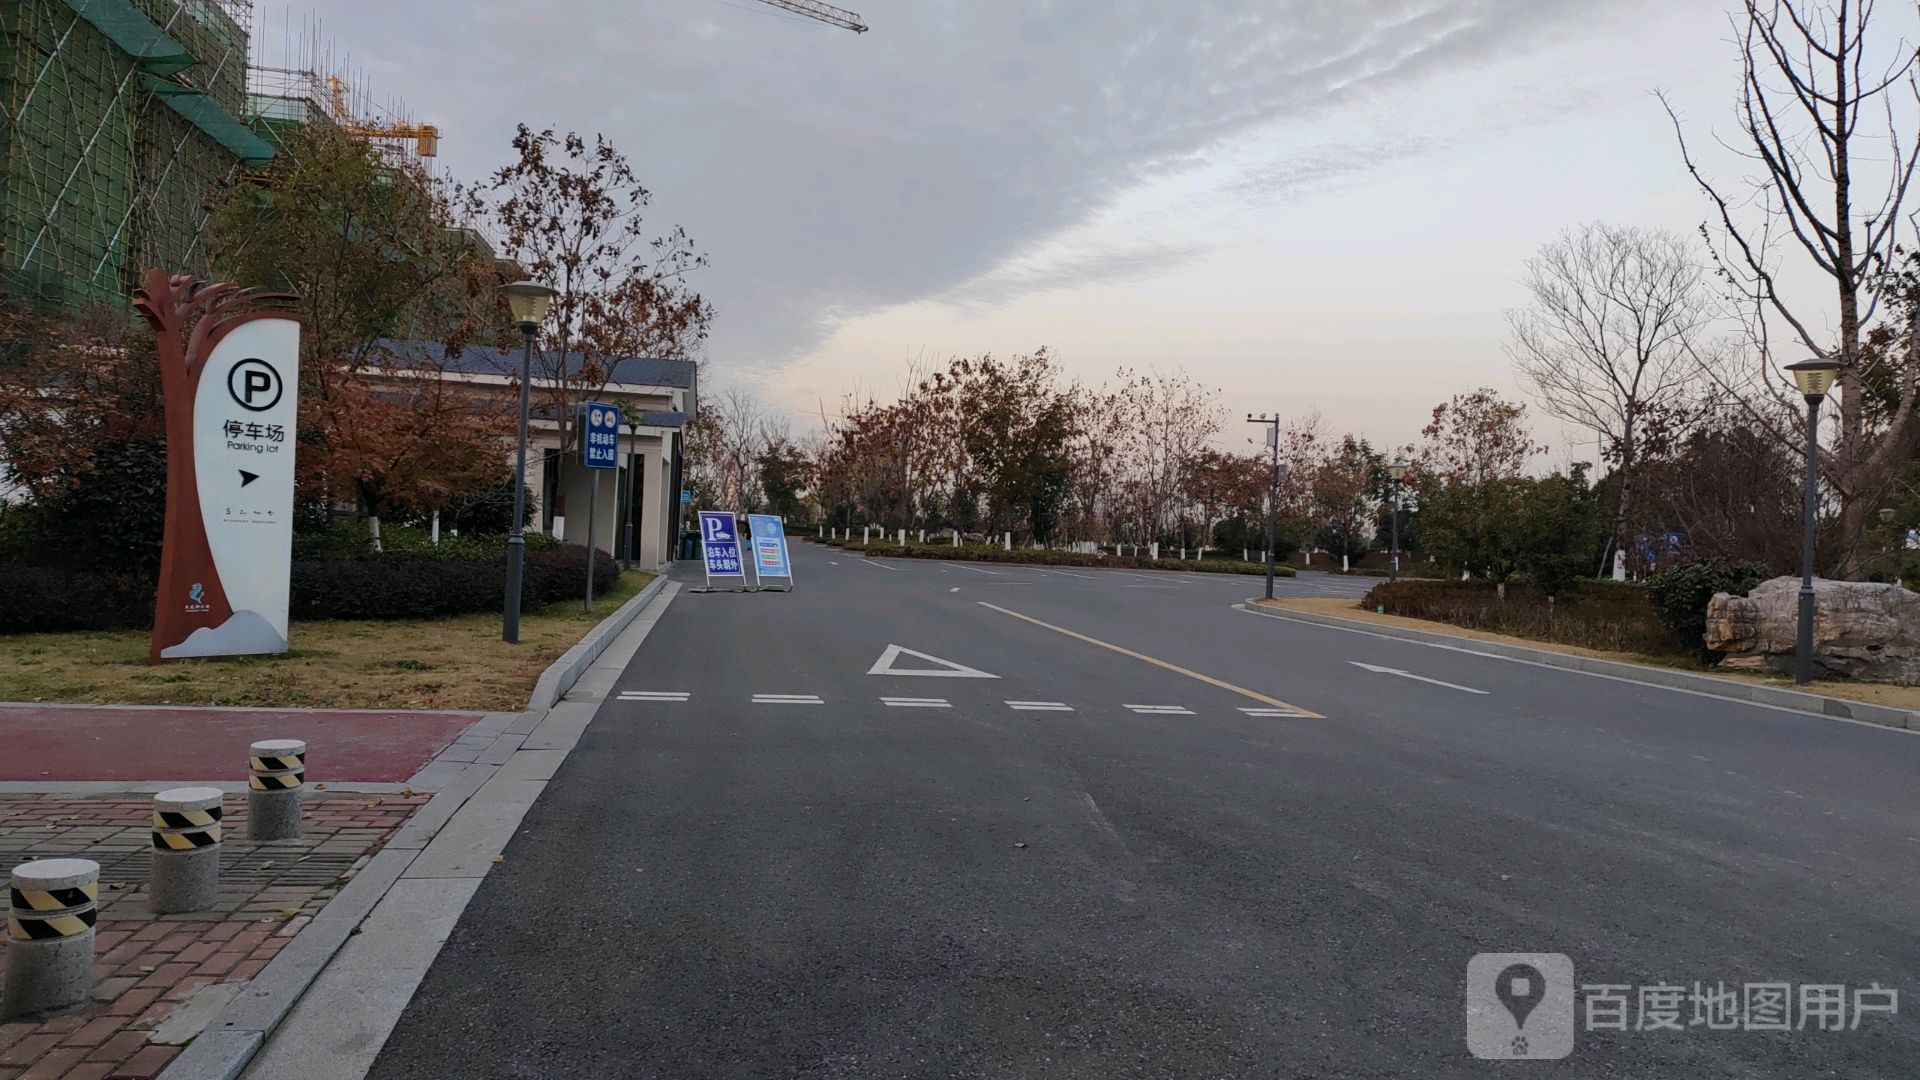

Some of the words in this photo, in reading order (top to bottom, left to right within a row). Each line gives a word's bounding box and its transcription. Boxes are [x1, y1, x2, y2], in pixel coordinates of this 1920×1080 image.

[245, 370, 271, 403] P
[223, 419, 285, 442] 停车场
[590, 432, 616, 446] 非机动车
[227, 441, 264, 454] Parking
[266, 444, 279, 453] lot
[705, 517, 722, 541] P
[707, 546, 737, 558] 泊车入位
[708, 559, 738, 570] 车头朝外
